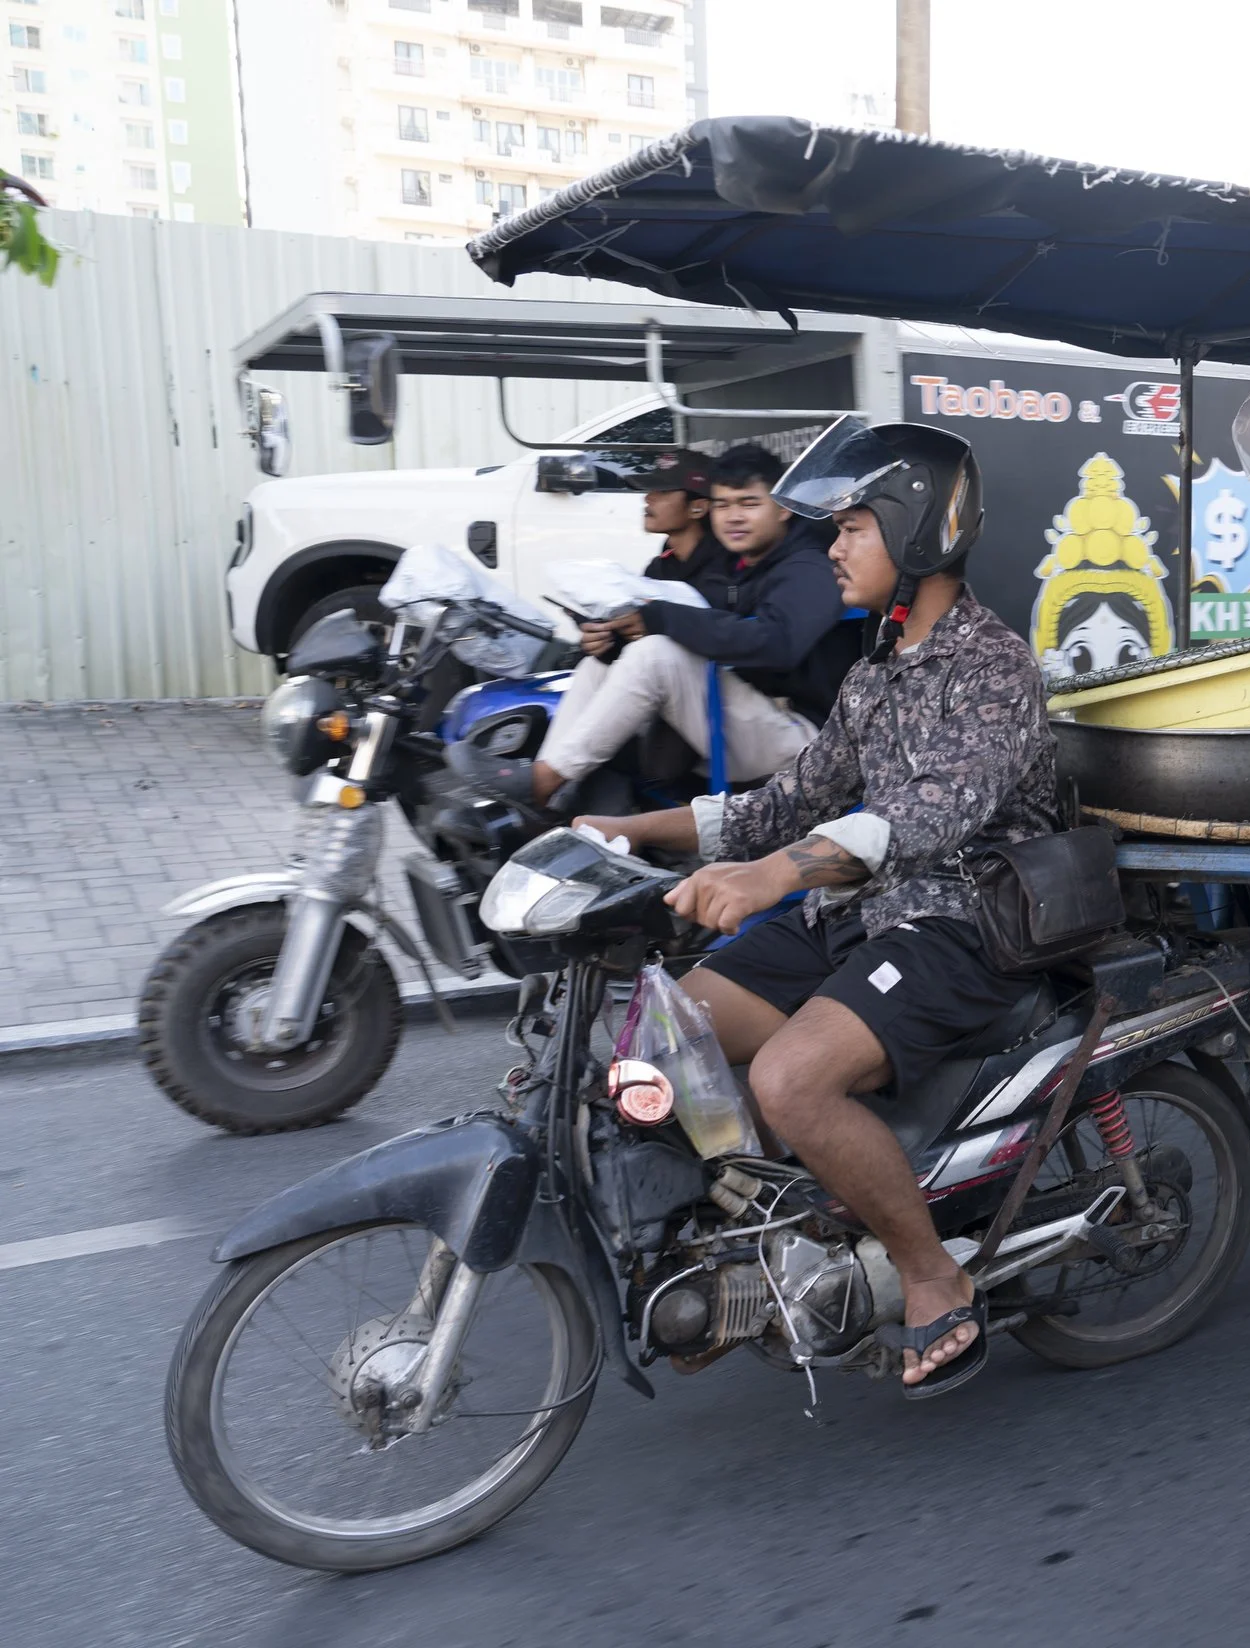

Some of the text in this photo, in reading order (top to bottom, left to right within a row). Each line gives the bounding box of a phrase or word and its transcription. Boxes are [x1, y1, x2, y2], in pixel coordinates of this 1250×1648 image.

[910, 375, 1071, 422] Taobao
[1077, 400, 1101, 423] &
[1113, 1006, 1210, 1050] Dream
